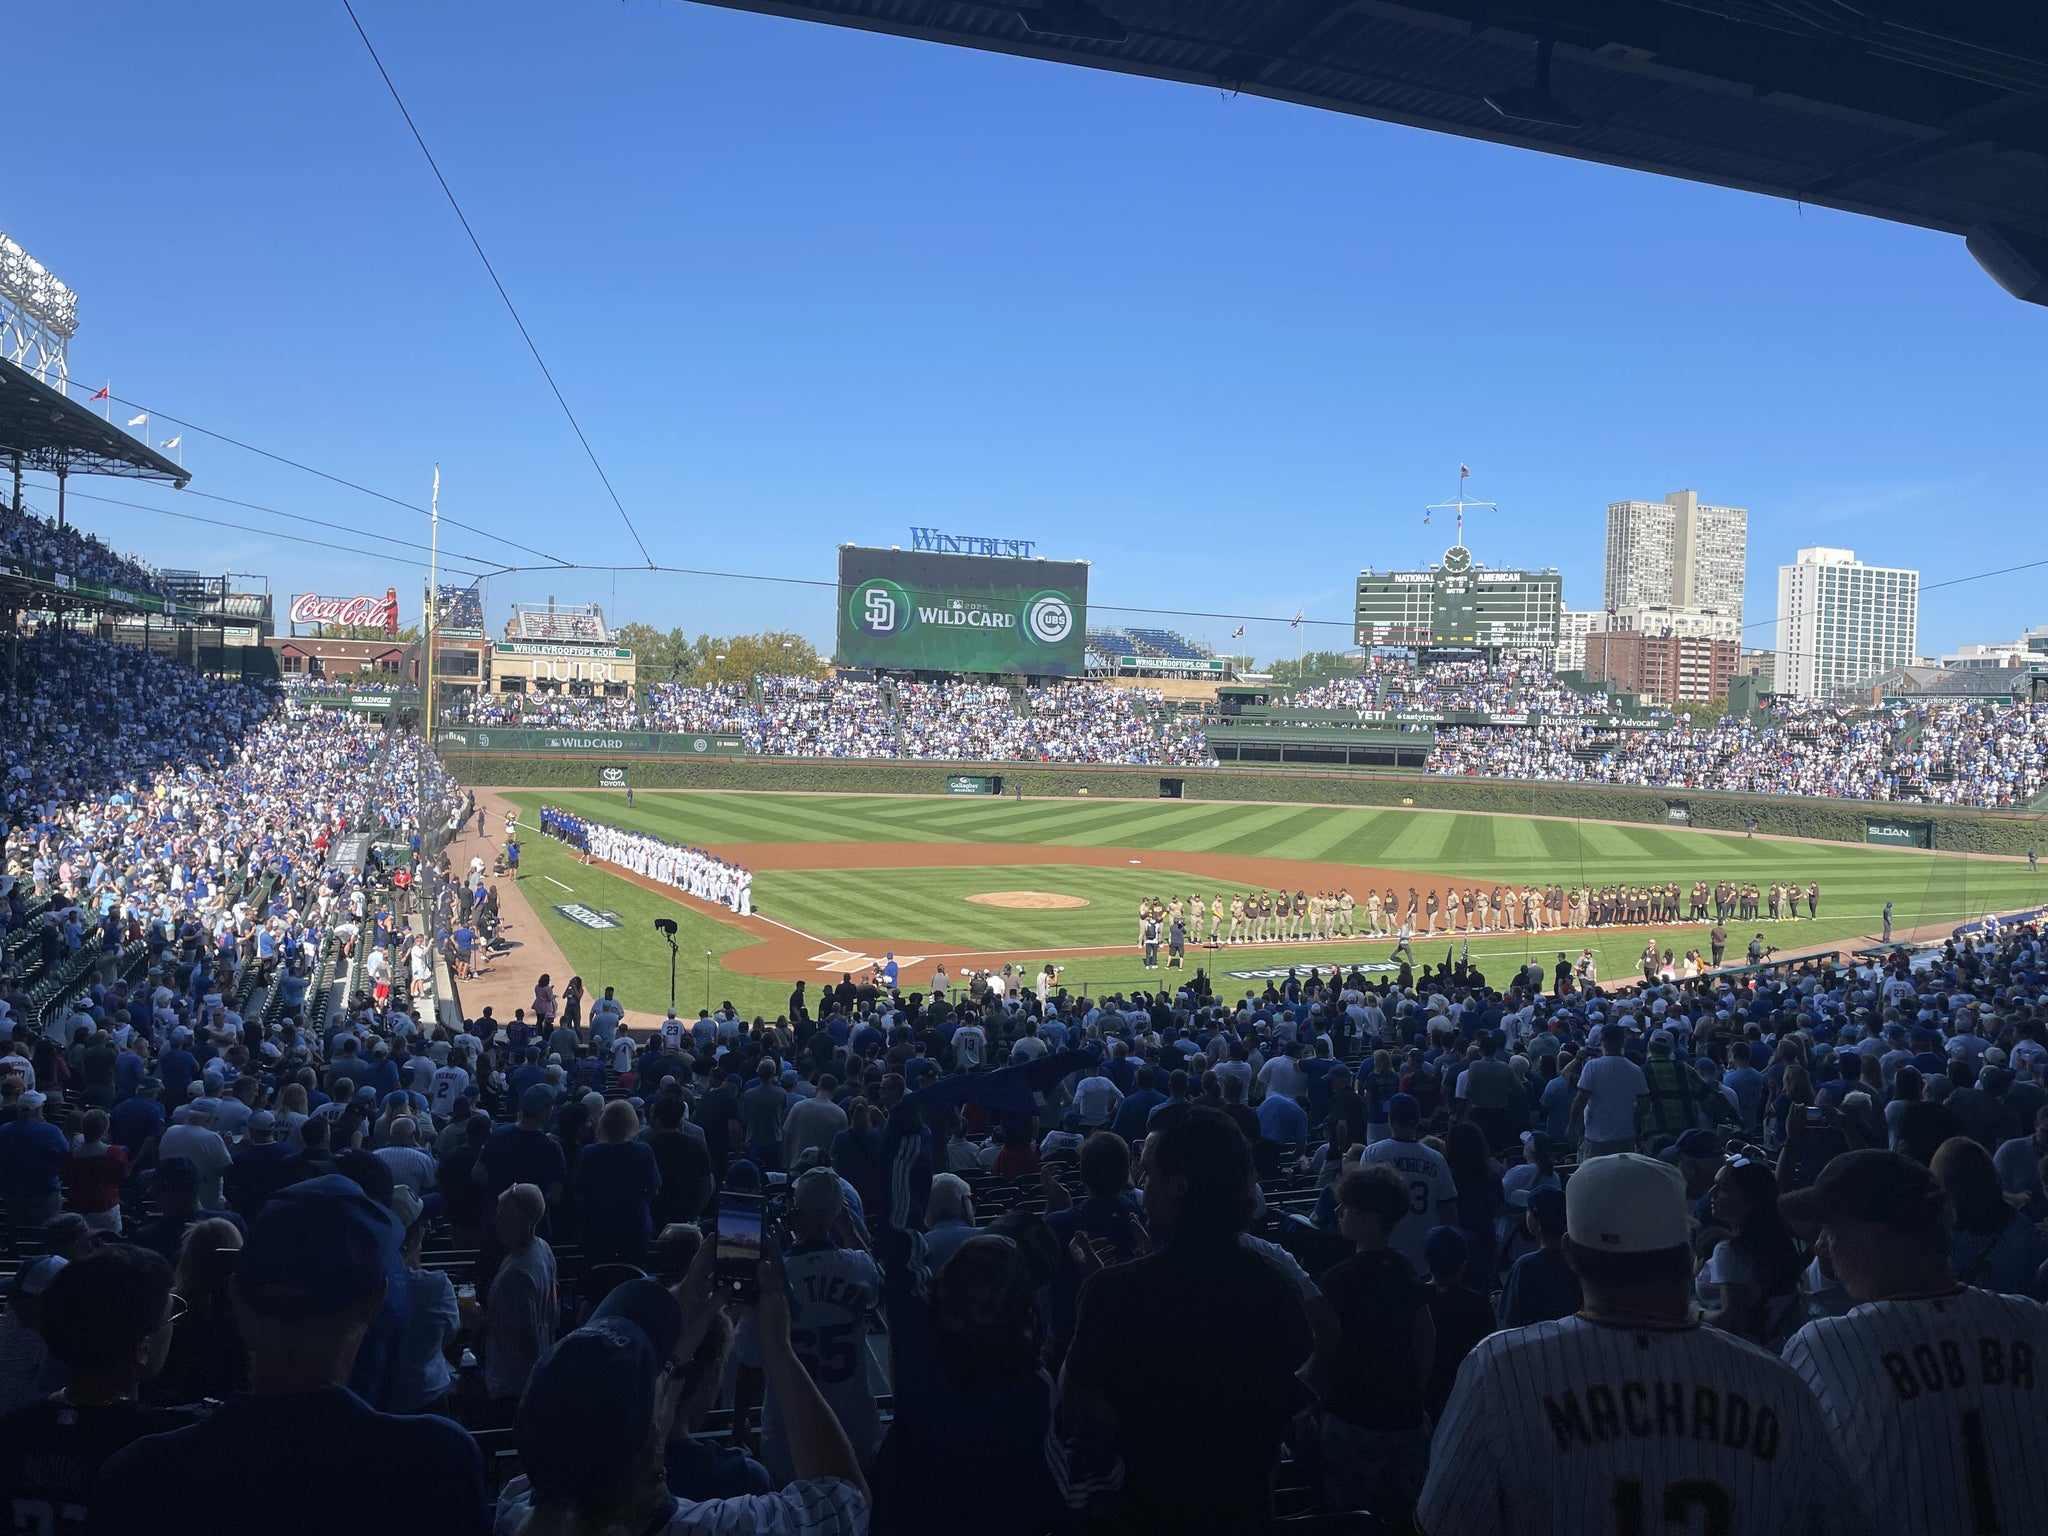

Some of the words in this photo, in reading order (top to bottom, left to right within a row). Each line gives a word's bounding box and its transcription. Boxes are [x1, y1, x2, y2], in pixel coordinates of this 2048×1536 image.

[909, 526, 1036, 559] WINTRUST
[1394, 574, 1435, 582] NATIONAL
[1477, 573, 1520, 582] AMERICAN
[513, 643, 617, 657] WRIGLEYROOFTOPS.COM
[1136, 659, 1211, 669] WRIGLEYROOFTOPS.COM
[351, 695, 392, 704] GRAINGER
[1356, 710, 1386, 720] YETI
[1402, 713, 1445, 721] tastytrade
[1620, 718, 1659, 727] Advocate
[449, 731, 467, 745] BEAM
[950, 782, 979, 790] Gallagher
[1868, 826, 1910, 838] SLOAN
[666, 1025, 679, 1036] 23
[964, 1038, 975, 1051] 13
[437, 1081, 449, 1098] 2
[1880, 1339, 1966, 1400] BOB
[1542, 1379, 1781, 1462] MACHADO
